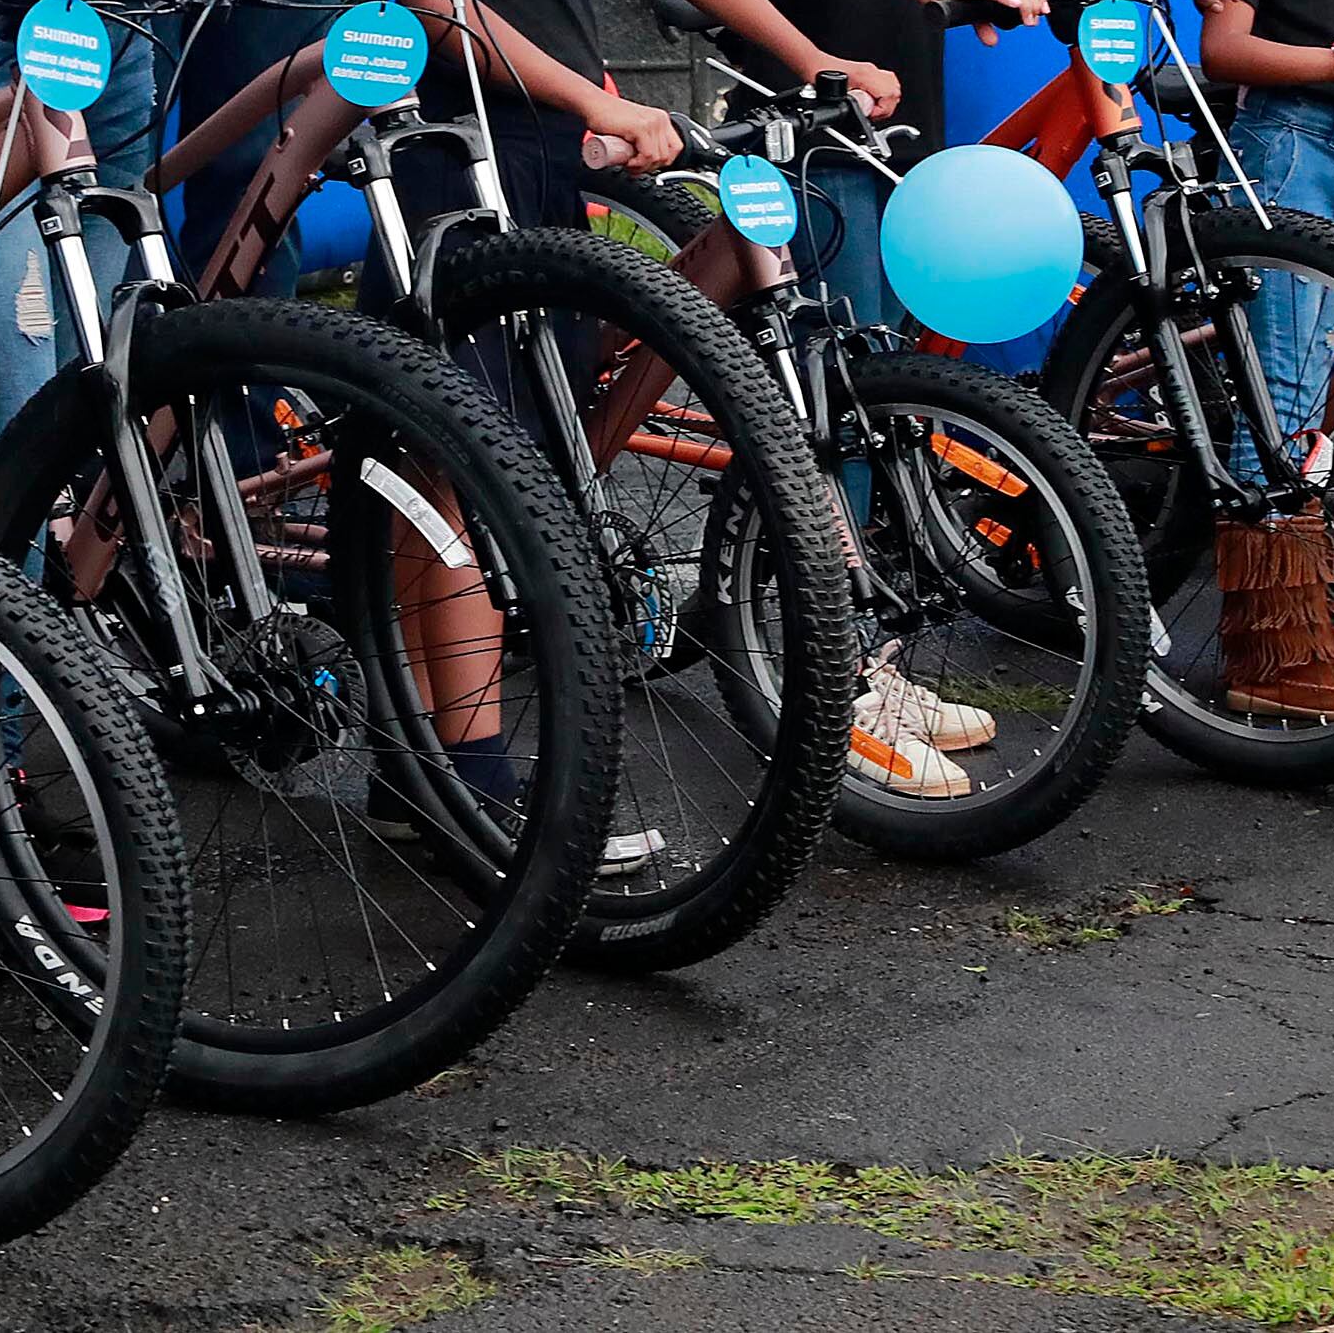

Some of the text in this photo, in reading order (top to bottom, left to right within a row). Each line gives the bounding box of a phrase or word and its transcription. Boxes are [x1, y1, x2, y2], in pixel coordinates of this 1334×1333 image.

[33, 25, 99, 51] SHIMANO
[342, 29, 414, 49] SHIMANO
[728, 181, 781, 195] SHIMANO
[717, 485, 753, 605] KEN
[14, 914, 105, 1016] ENDA
